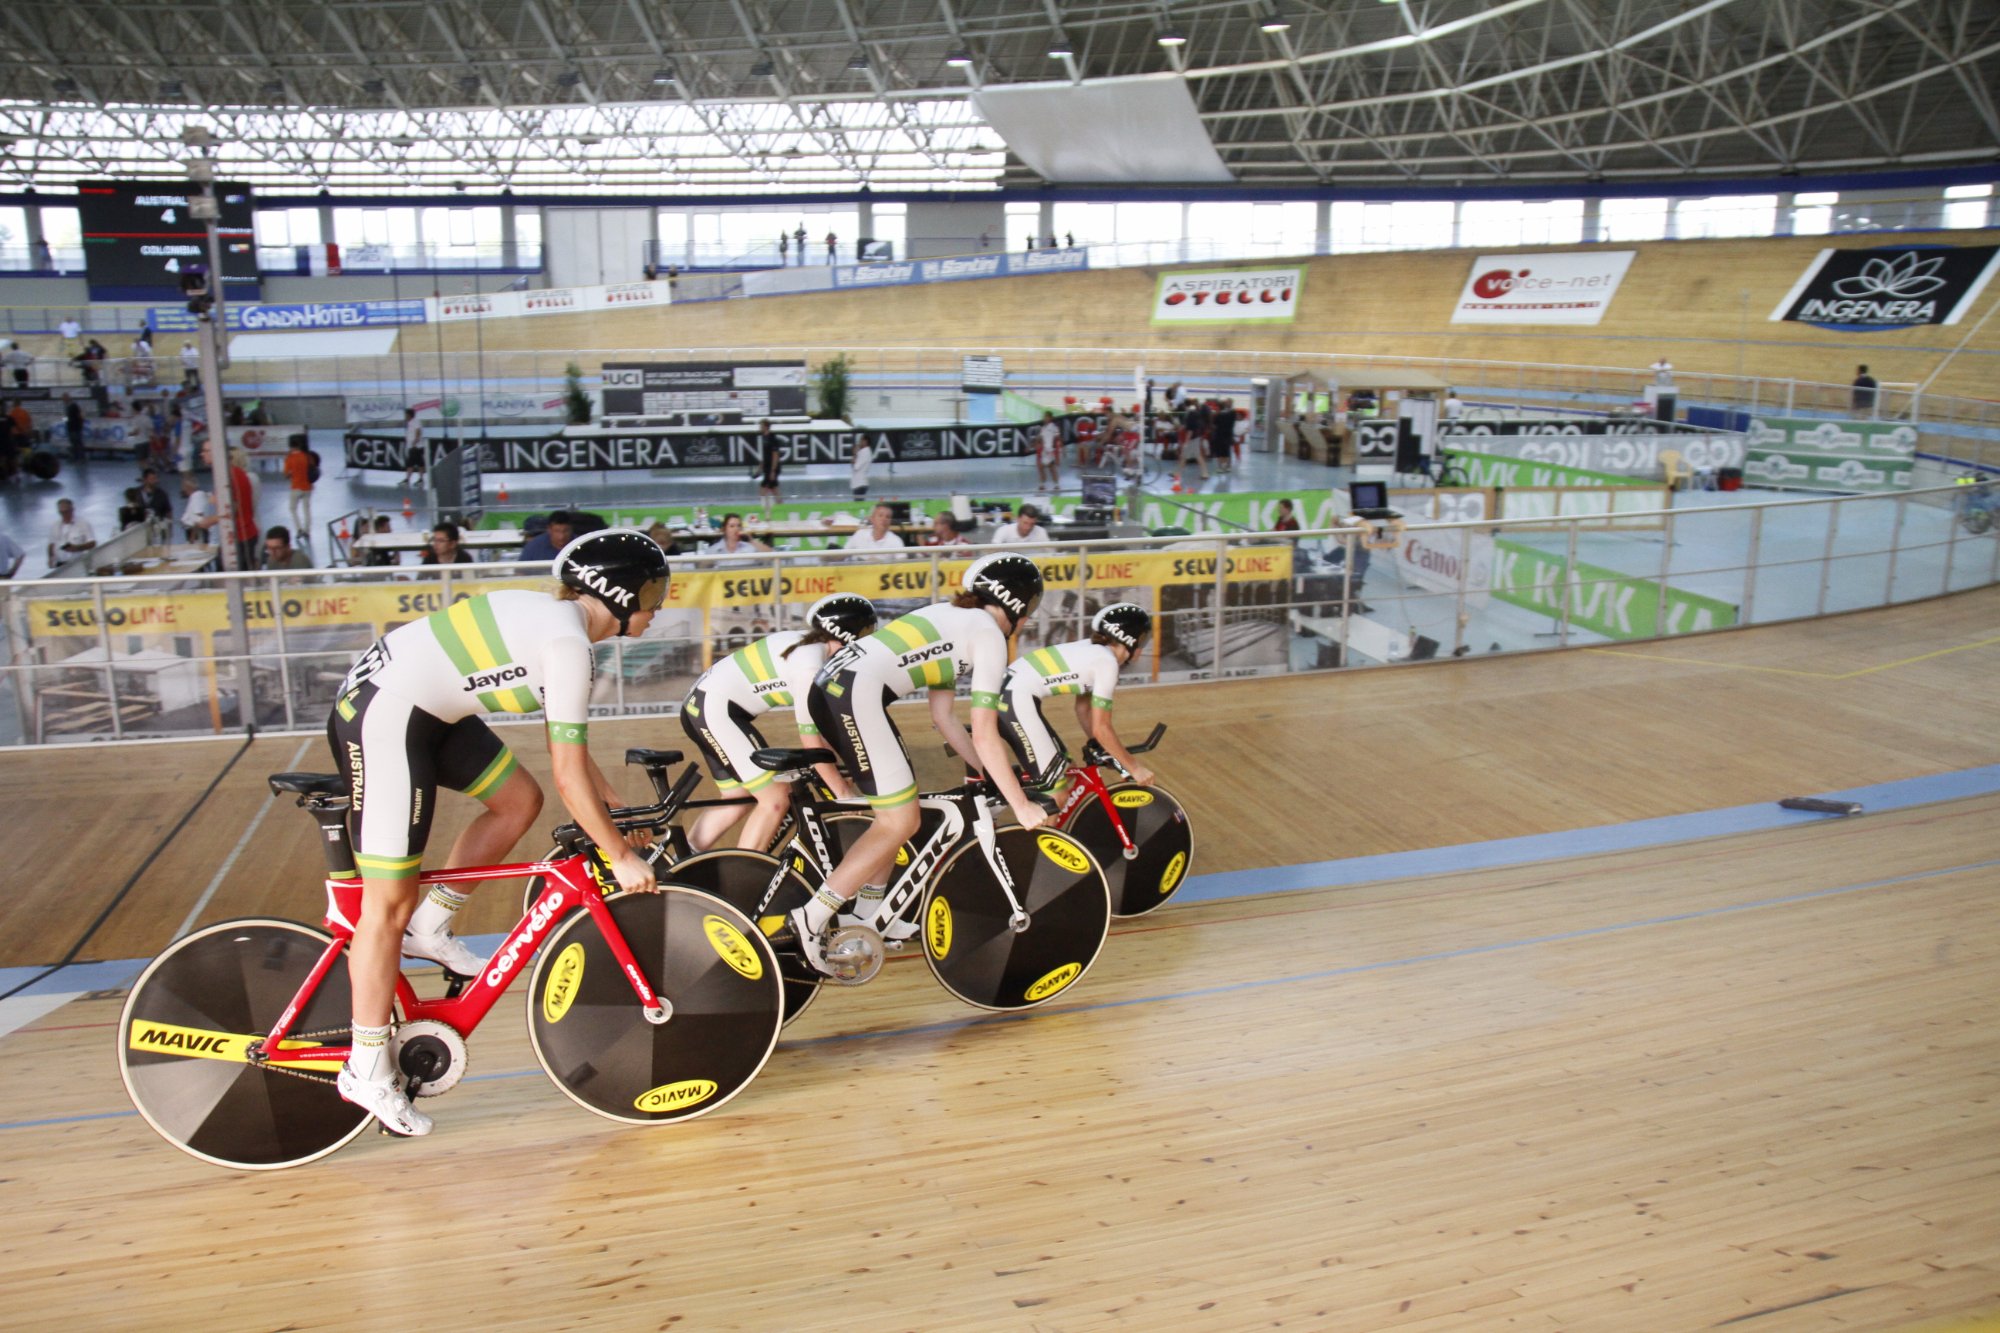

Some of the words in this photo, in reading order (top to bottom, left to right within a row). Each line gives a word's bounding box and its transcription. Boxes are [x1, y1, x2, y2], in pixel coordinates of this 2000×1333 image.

[134, 195, 189, 207] AUSTRAL
[160, 208, 177, 224] 4
[164, 257, 180, 273] 4
[1166, 275, 1294, 291] ASPIRATORI
[1164, 288, 1292, 306] OTELLI
[1800, 299, 1936, 319] INGENERA
[608, 373, 639, 385] UCI
[504, 437, 678, 469] INGENERA
[897, 641, 954, 668] Jayco
[463, 665, 528, 691] Jayco
[752, 680, 787, 694] Jayco
[1043, 672, 1080, 686] Jayco
[699, 727, 730, 767] AUSTRALIA
[840, 712, 870, 773] AUSTRALIA
[1010, 721, 1036, 764] AUSTRALIA
[346, 740, 365, 812] AUSTRALIA
[928, 793, 964, 801] LOOK
[1118, 793, 1146, 804] MAVIC
[995, 846, 1016, 887] LOOK
[1047, 841, 1082, 868] MAVIC
[758, 860, 791, 913] LOOK
[875, 819, 958, 932] LOOK
[1164, 861, 1181, 891] MAVIC
[487, 891, 564, 988] cervélo
[935, 907, 947, 949] MAVIC
[714, 924, 754, 969] MAVIC
[551, 958, 577, 1009] MAVIC
[626, 963, 652, 1001] cervélo
[1036, 968, 1072, 993] MAVIC
[138, 1029, 231, 1054] MAVIC
[650, 1084, 702, 1107] MAVIC
